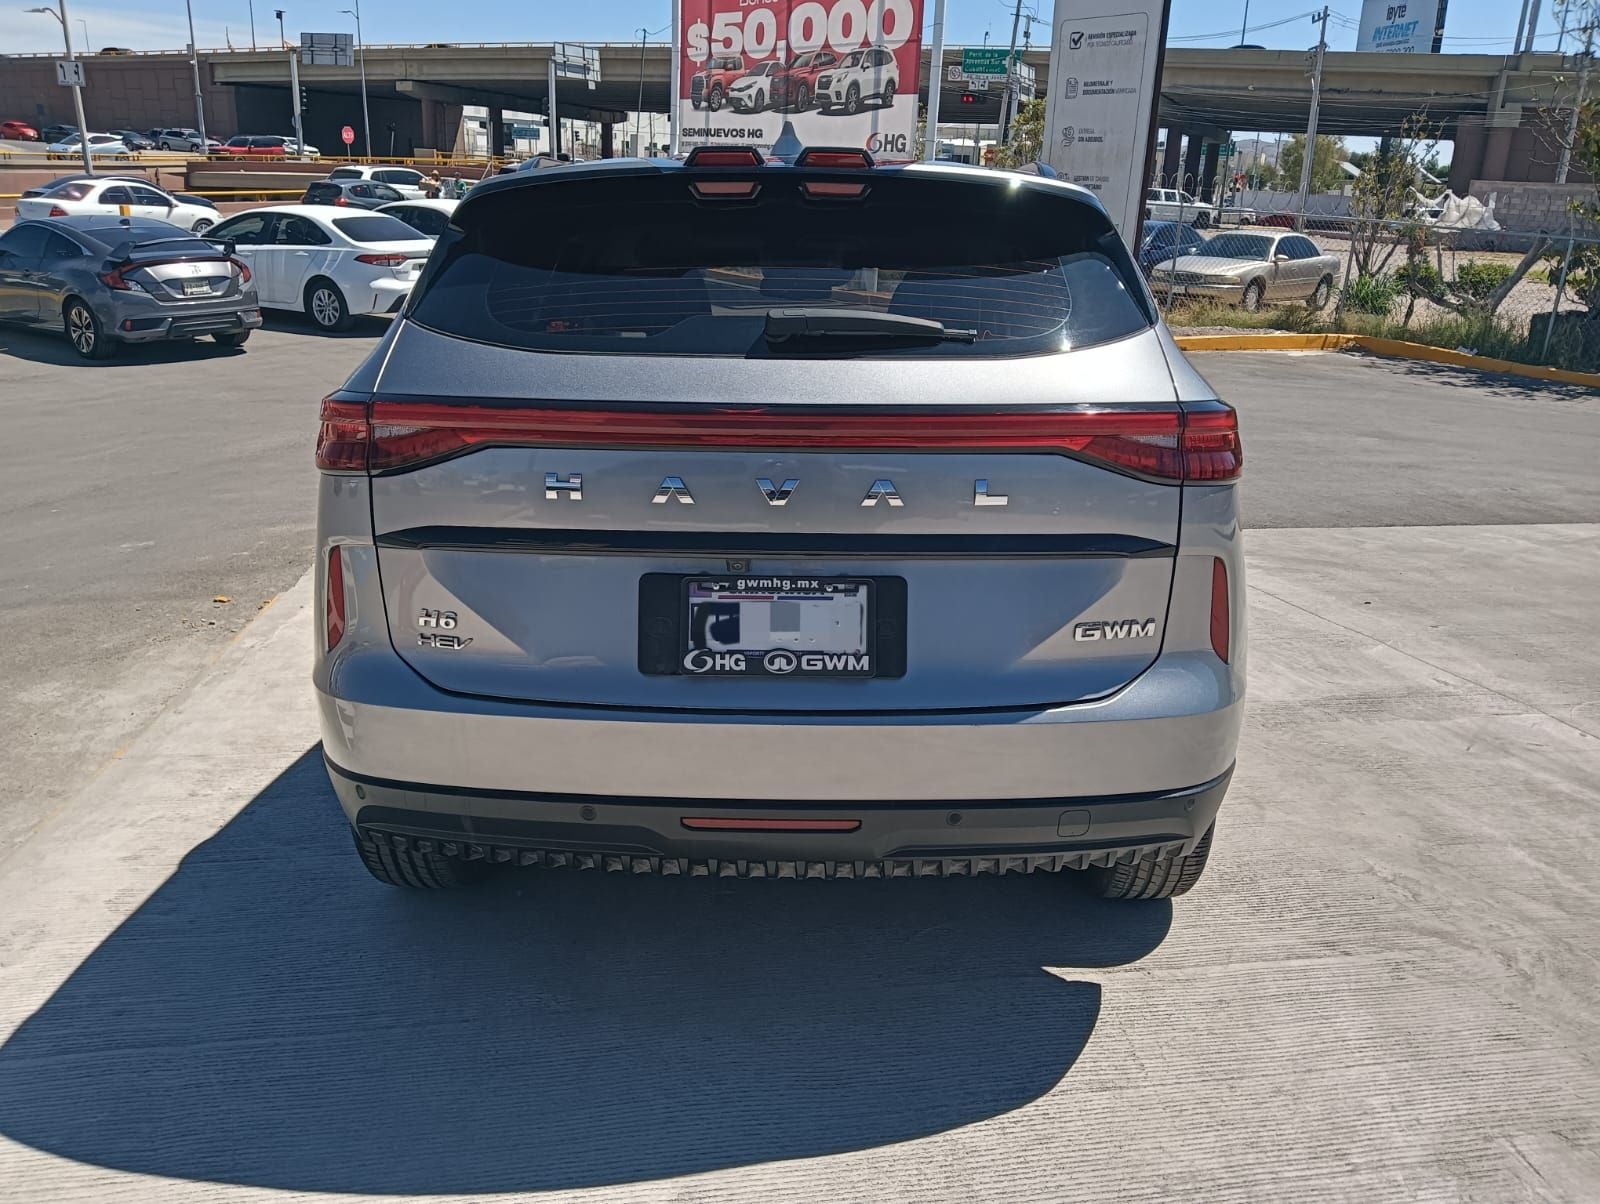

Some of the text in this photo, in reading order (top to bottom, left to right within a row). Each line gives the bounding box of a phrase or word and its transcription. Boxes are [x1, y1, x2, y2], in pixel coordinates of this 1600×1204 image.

[686, 0, 914, 67] $50,000
[1372, 20, 1419, 41] INTERNET
[681, 128, 763, 139] SEMINUEVOS HG
[883, 133, 907, 153] HG
[545, 472, 1009, 507] HAVAL
[736, 578, 820, 591] gwmhg.mx
[417, 608, 458, 630] H6
[1073, 618, 1157, 642] GWM
[416, 633, 474, 650] HEV
[714, 653, 746, 671] HG
[801, 654, 870, 671] GWM
